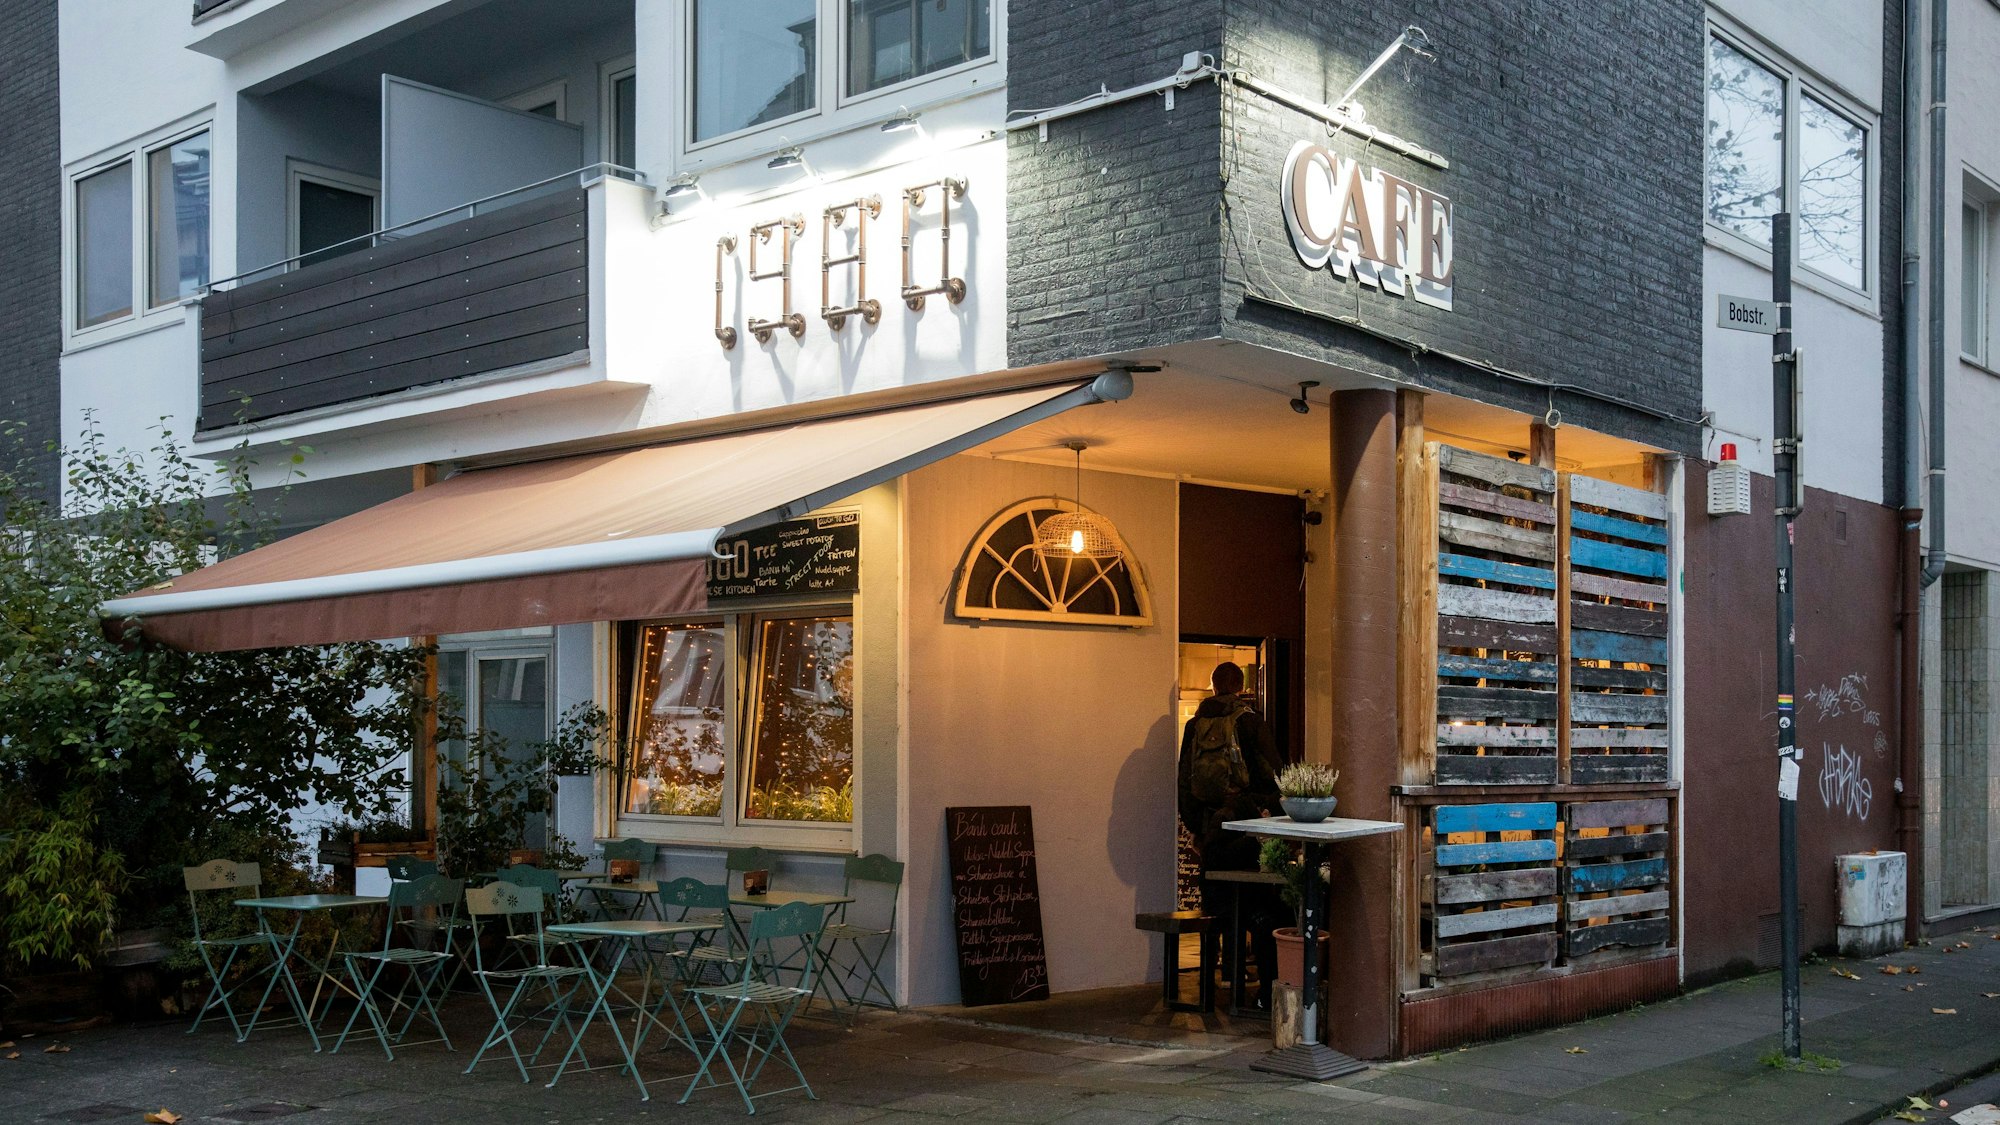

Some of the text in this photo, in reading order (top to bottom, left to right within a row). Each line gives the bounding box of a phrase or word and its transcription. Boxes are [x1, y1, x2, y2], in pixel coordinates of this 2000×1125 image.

[1286, 142, 1453, 289] CAFE
[714, 175, 968, 350] 1980
[1729, 301, 1767, 326] Bobstr.
[753, 543, 778, 560] TEE
[782, 538, 805, 549] SWEET
[827, 547, 856, 560] FRITTEN
[785, 540, 833, 590] STREET FOOD
[815, 564, 852, 576] Nudelsuppe
[753, 576, 779, 587] Tarte
[725, 585, 756, 596] KITCHEN
[954, 812, 987, 841] Bánh
